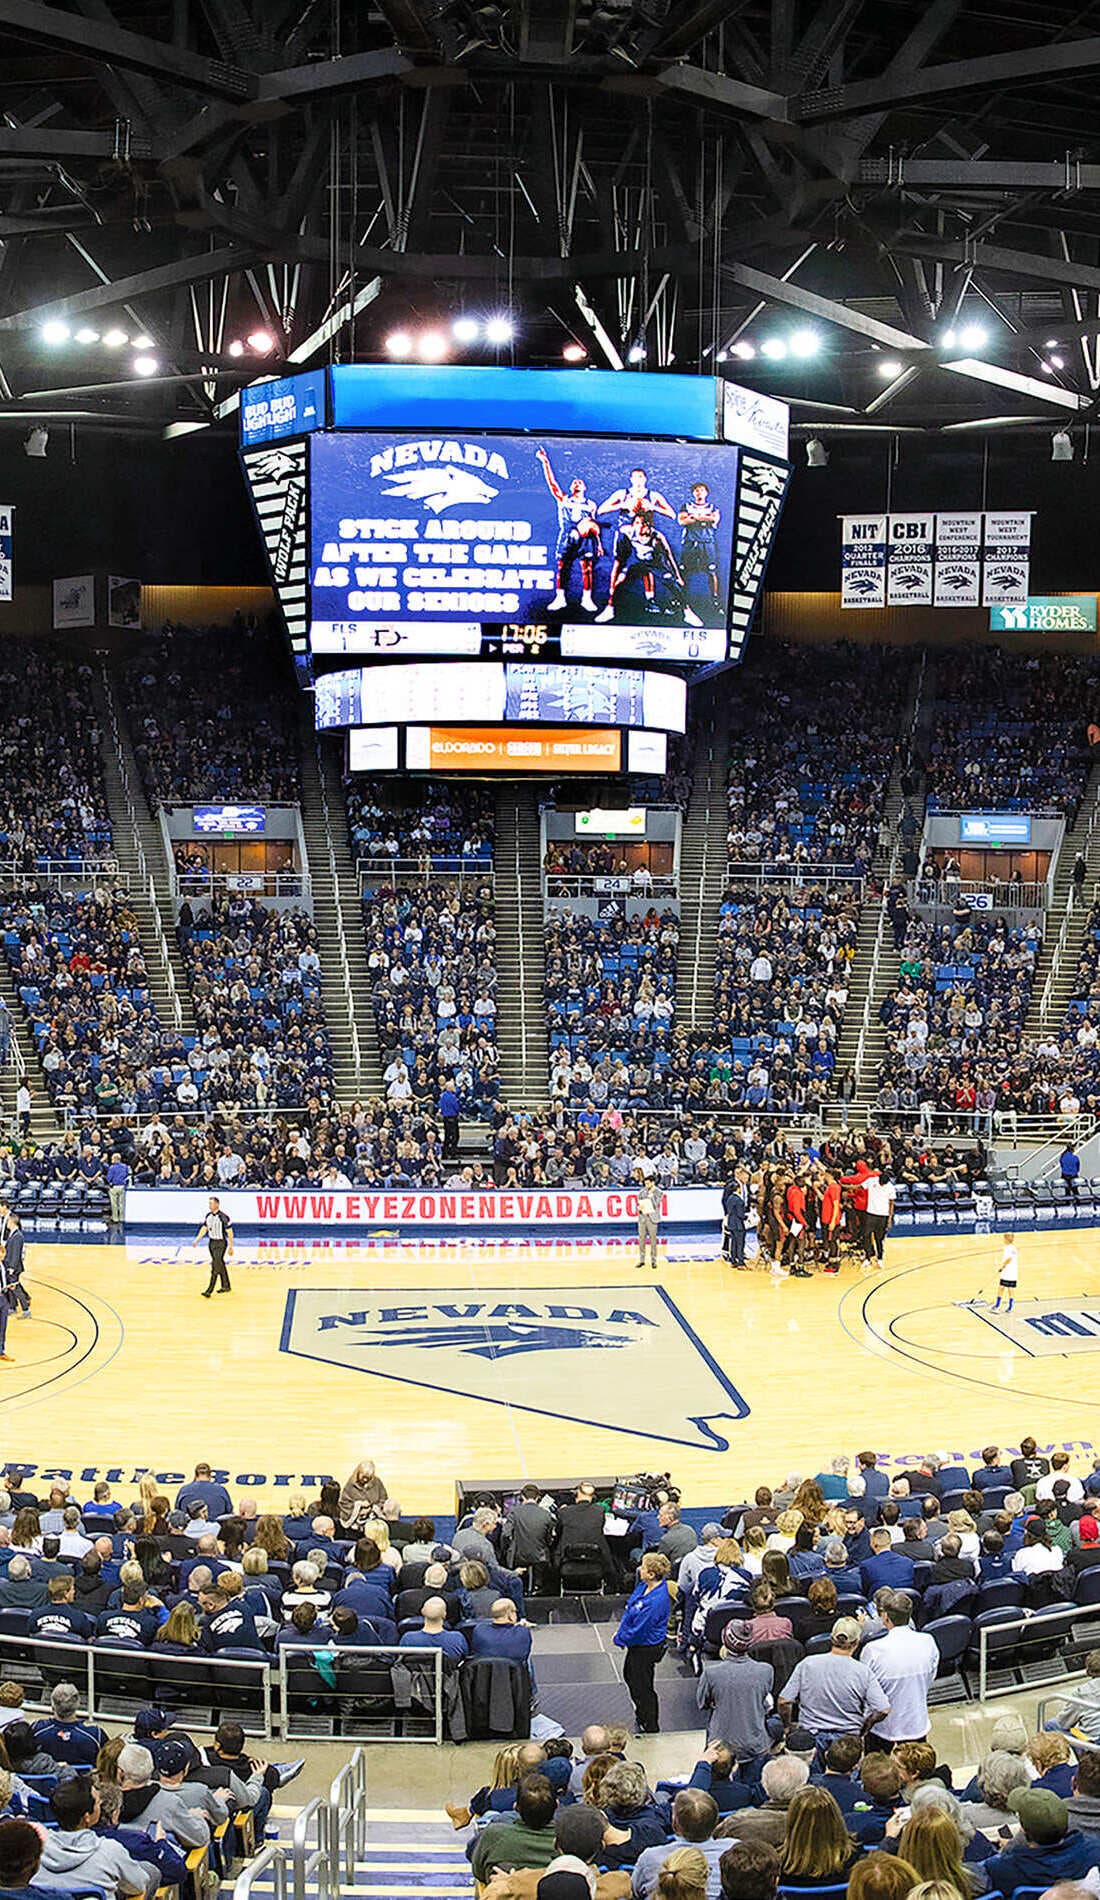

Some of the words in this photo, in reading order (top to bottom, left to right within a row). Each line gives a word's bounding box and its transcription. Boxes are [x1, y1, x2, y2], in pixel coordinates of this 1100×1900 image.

[245, 402, 269, 420] BUD
[271, 395, 295, 413] BUD
[370, 440, 510, 480] NEVADA
[274, 528, 292, 582] WOLF
[284, 484, 301, 529] PACK
[339, 519, 419, 539] STICK
[424, 519, 532, 541] AROUND
[852, 524, 878, 539] NIT
[893, 523, 927, 539] CBI
[740, 540, 760, 587] WOLF
[757, 502, 779, 546] PACK
[894, 544, 926, 554] 2016
[996, 546, 1018, 554] 2017
[321, 543, 408, 563] AFTER
[413, 543, 470, 564] THE
[473, 545, 548, 565] GAME
[844, 552, 884, 560] QUARTER
[889, 554, 931, 562] CHAMPIONS
[313, 567, 350, 587] AS
[354, 567, 398, 587] WE
[403, 568, 555, 589] CELEBRATE
[844, 569, 882, 582] NEVADA
[891, 565, 929, 578] NEVADA
[938, 565, 977, 578] NEVADA
[987, 565, 1026, 579] NEVADA
[348, 591, 401, 611] OUR
[407, 592, 520, 613] SENIORS
[1029, 605, 1081, 617] RYDER
[237, 879, 253, 888] 22
[603, 879, 620, 889] 24
[966, 895, 988, 909] 26
[317, 1303, 661, 1332] NEVADA
[37, 1615, 71, 1627] NEVADA
[106, 1617, 142, 1632] NEVADA
